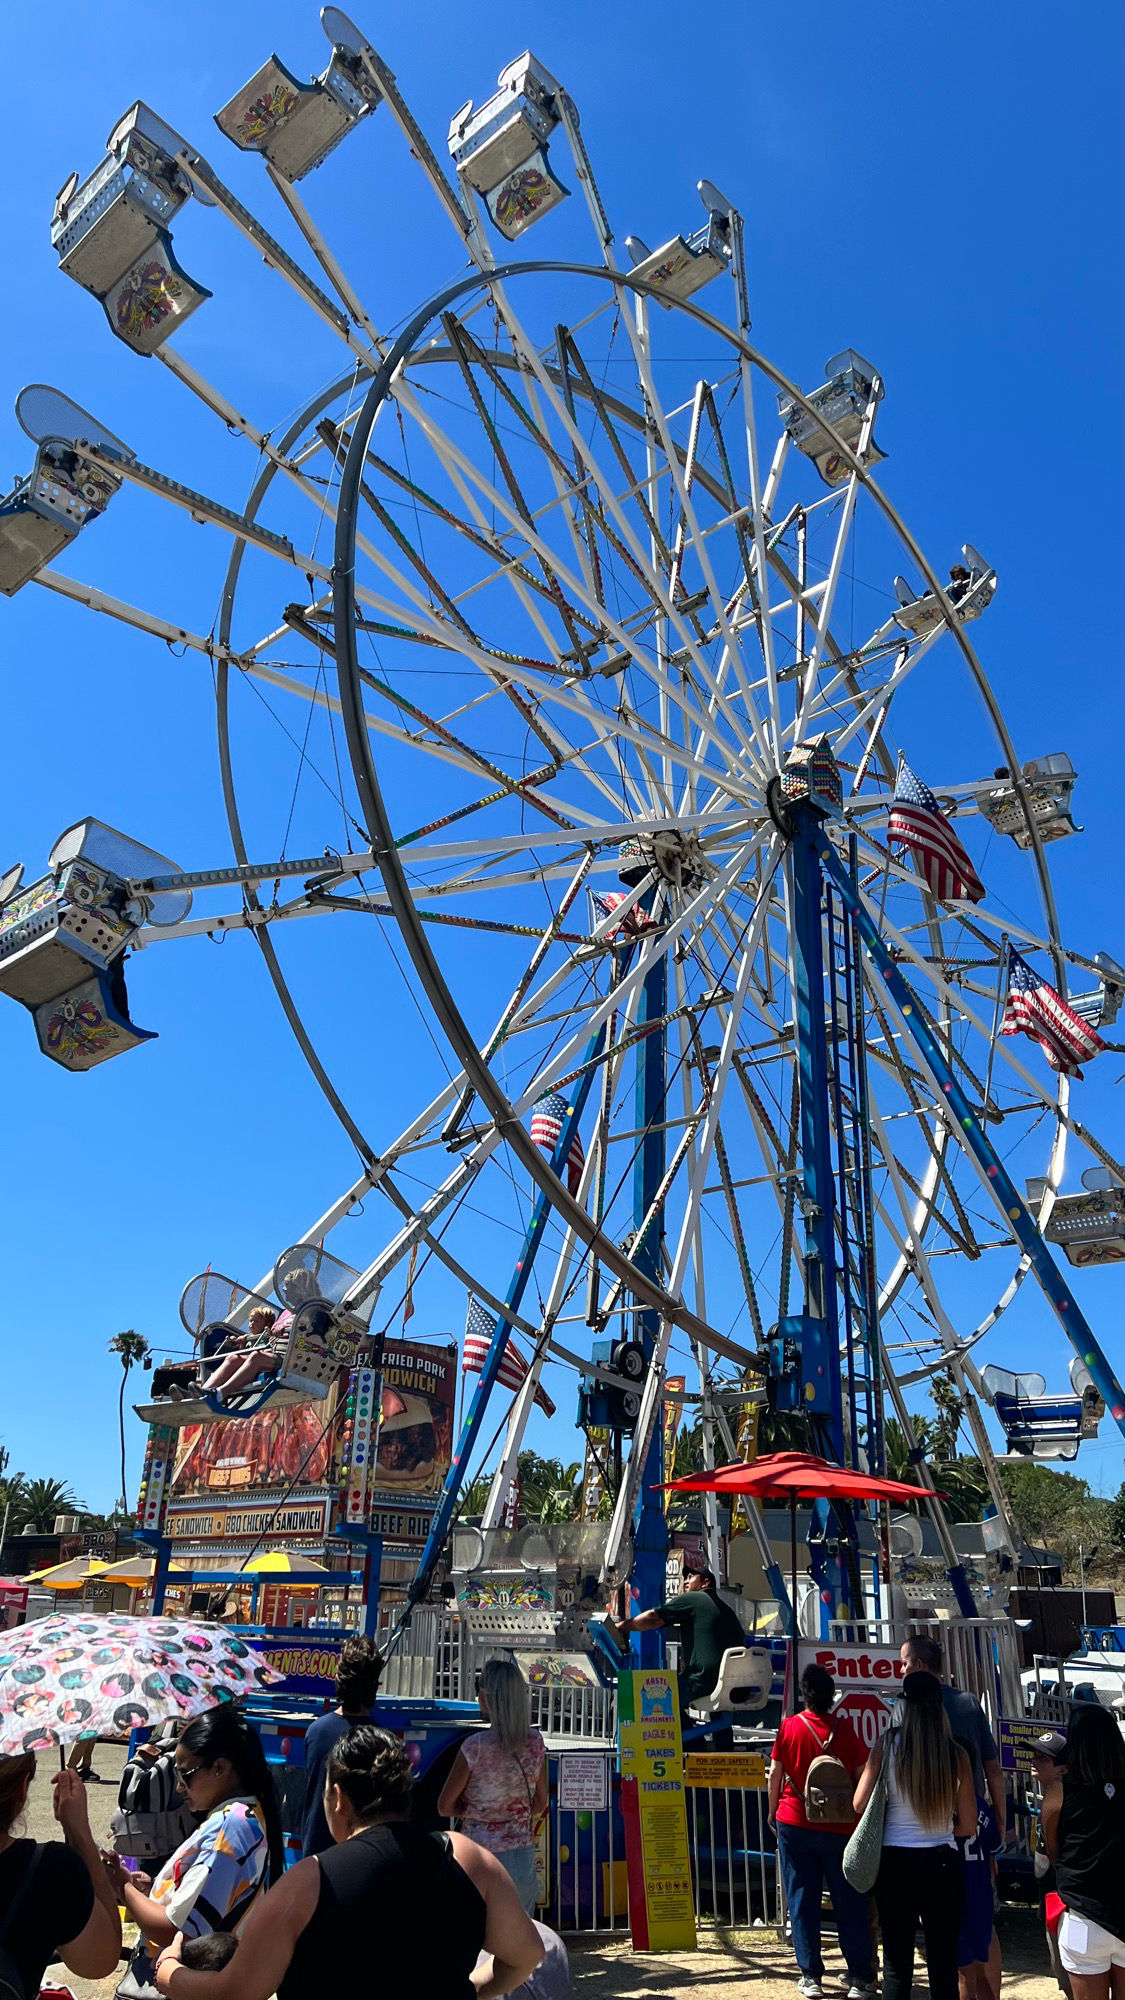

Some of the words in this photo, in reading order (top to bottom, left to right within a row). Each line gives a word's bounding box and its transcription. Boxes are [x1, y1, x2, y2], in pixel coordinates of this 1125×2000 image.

[381, 1353, 413, 1368] FRIED
[416, 1358, 446, 1379] PORK
[382, 1367, 437, 1394] NDWICH
[175, 1516, 214, 1536] SANDWICH
[225, 1515, 242, 1534] BBQ
[242, 1512, 275, 1532] CHICKEN
[276, 1510, 321, 1530] SANDWICH
[371, 1513, 404, 1534] BEEF
[407, 1516, 431, 1537] RIB
[815, 1651, 904, 1680] Enter
[1009, 1724, 1032, 1735] Smaller
[645, 1748, 675, 1758] TAKES
[1013, 1748, 1035, 1759] Everyo
[653, 1760, 666, 1778] 5
[641, 1781, 681, 1792] TICKETS
